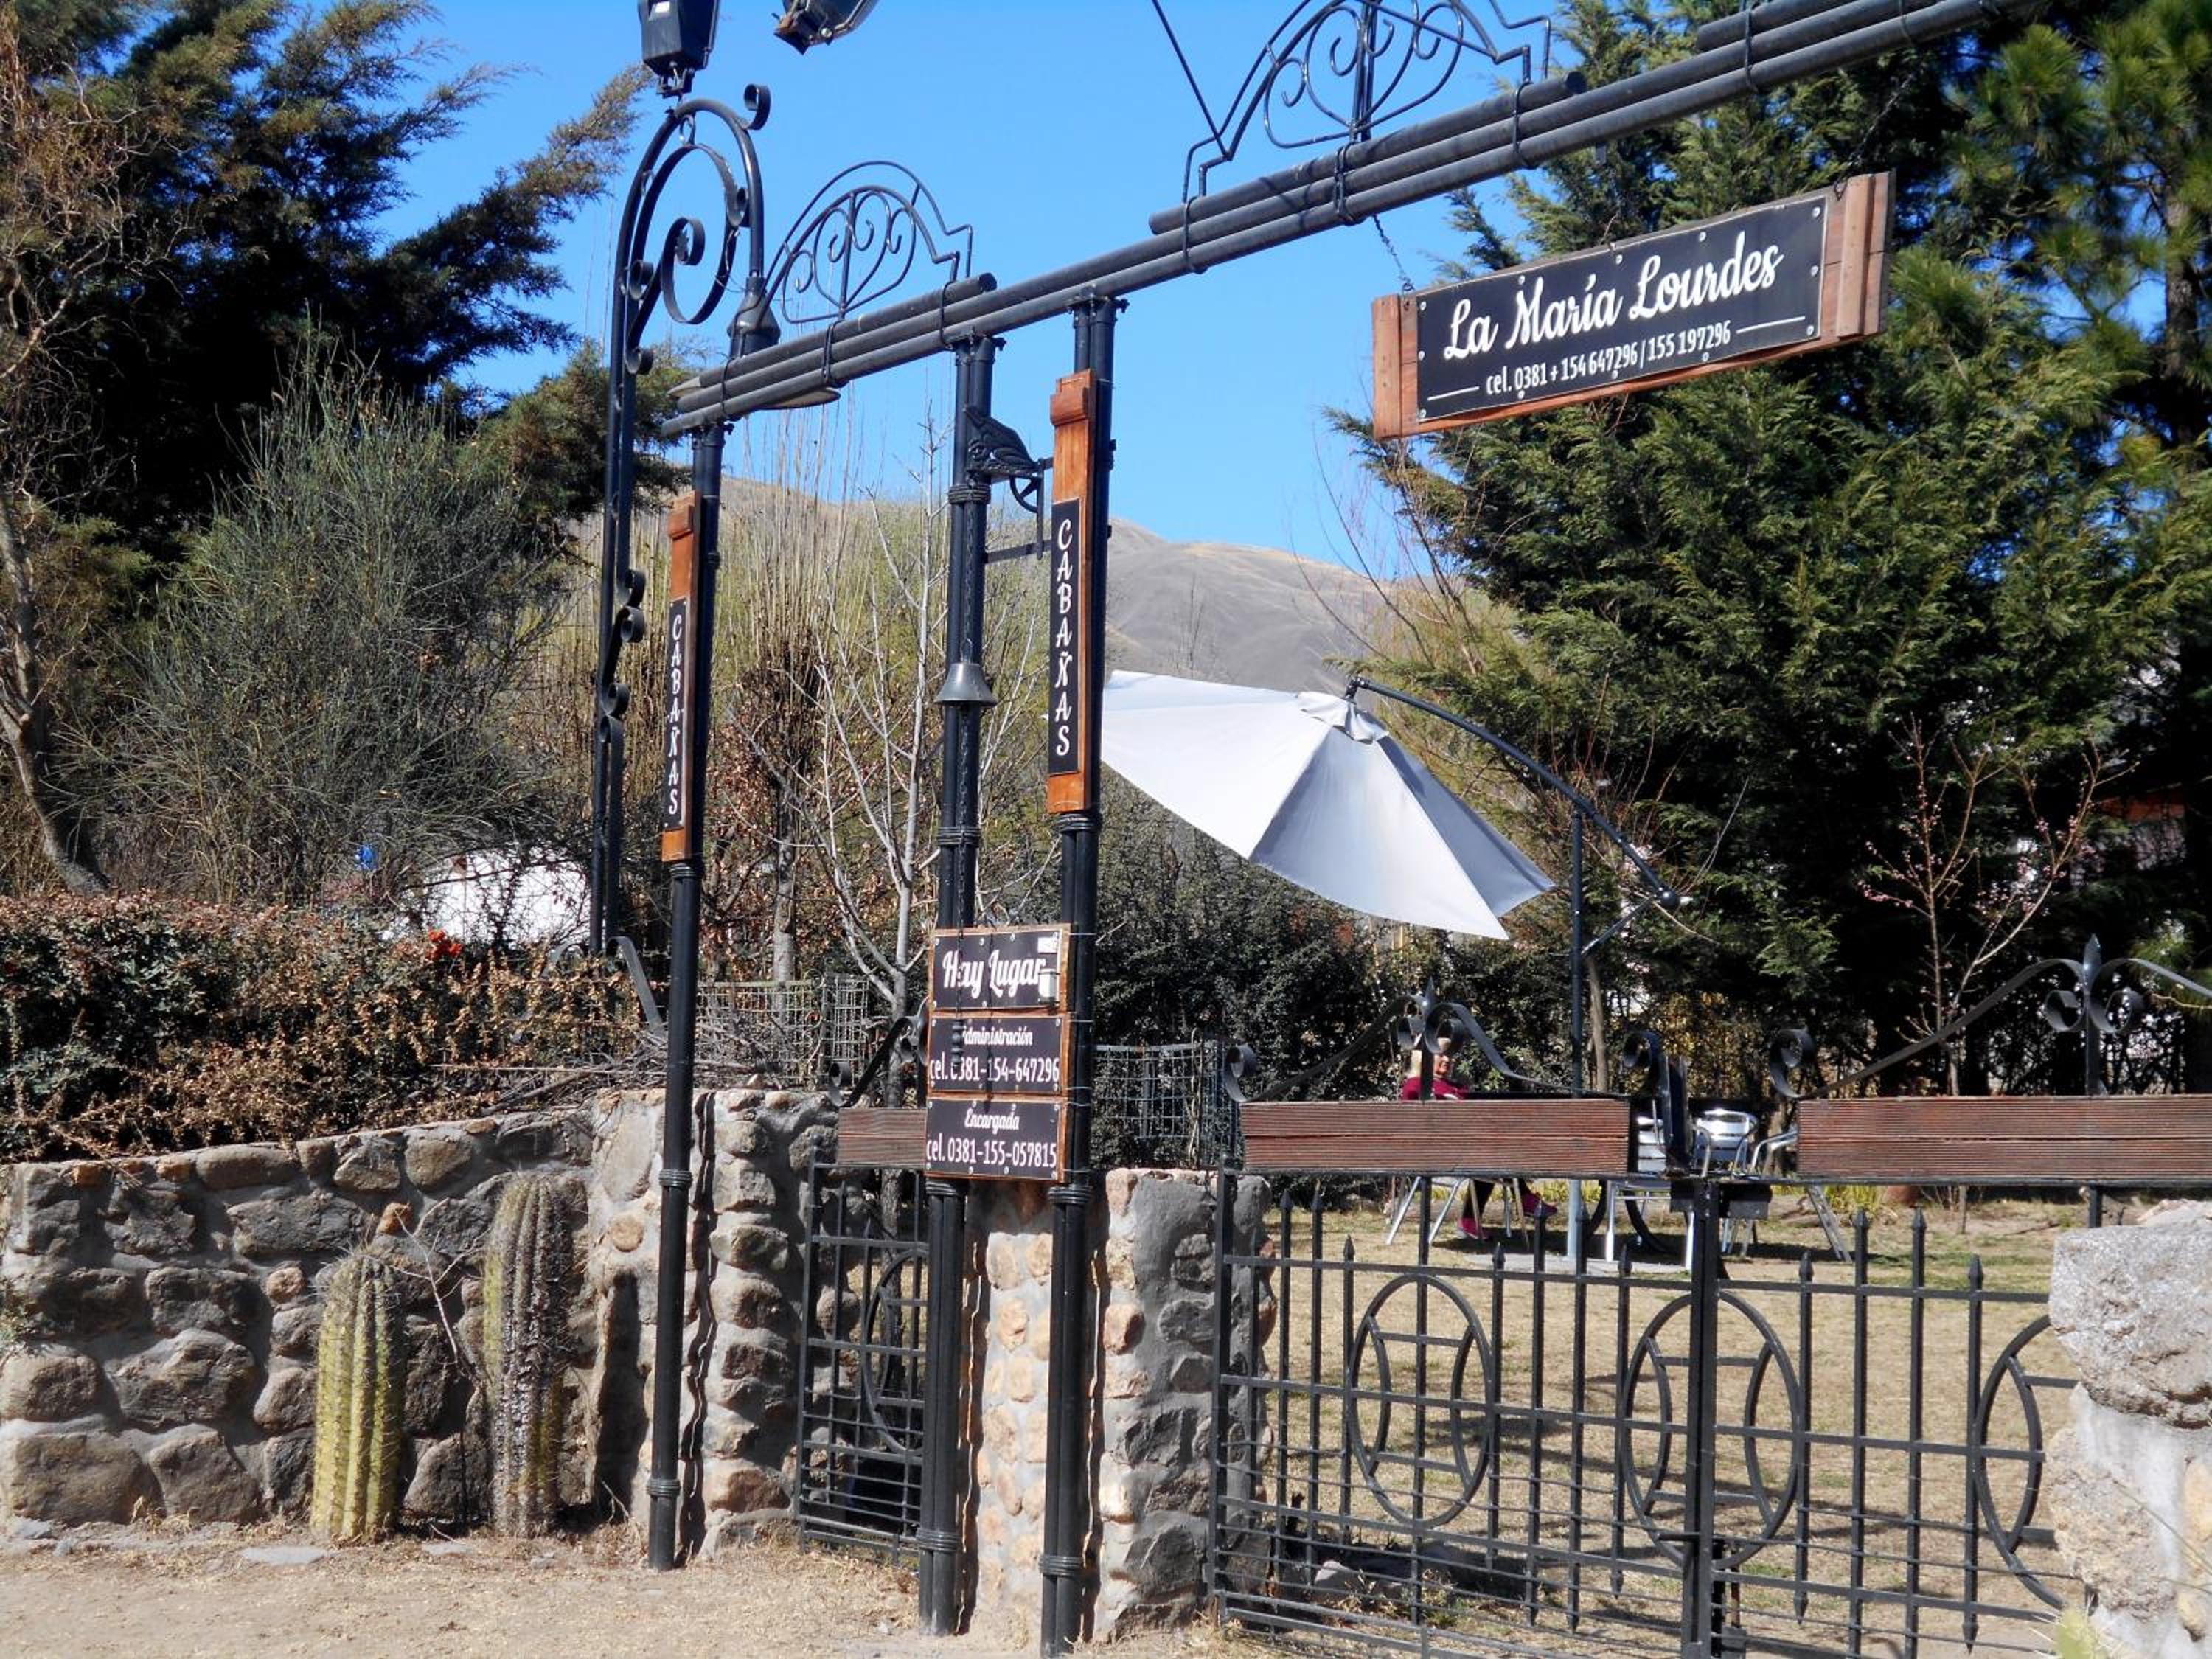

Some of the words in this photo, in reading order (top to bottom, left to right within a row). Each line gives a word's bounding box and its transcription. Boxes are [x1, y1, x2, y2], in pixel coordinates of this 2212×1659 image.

[1444, 298, 1498, 360] La
[1505, 274, 1623, 349] María
[1629, 229, 1784, 319] Lourdes
[1486, 365, 1512, 395] cel.
[1515, 362, 1548, 390] 0381
[1647, 333, 1674, 361] 155
[1677, 319, 1731, 355] 197296
[1054, 518, 1073, 757] CABAÑAS
[667, 614, 683, 815] CABAÑAS
[942, 949, 984, 999] Hay
[988, 949, 1046, 998] Lugar
[930, 1051, 949, 1080] cel.
[926, 1133, 945, 1162] cel.
[947, 1138, 1057, 1168] 0381-155-057815
[964, 1107, 1020, 1134] Encargada
